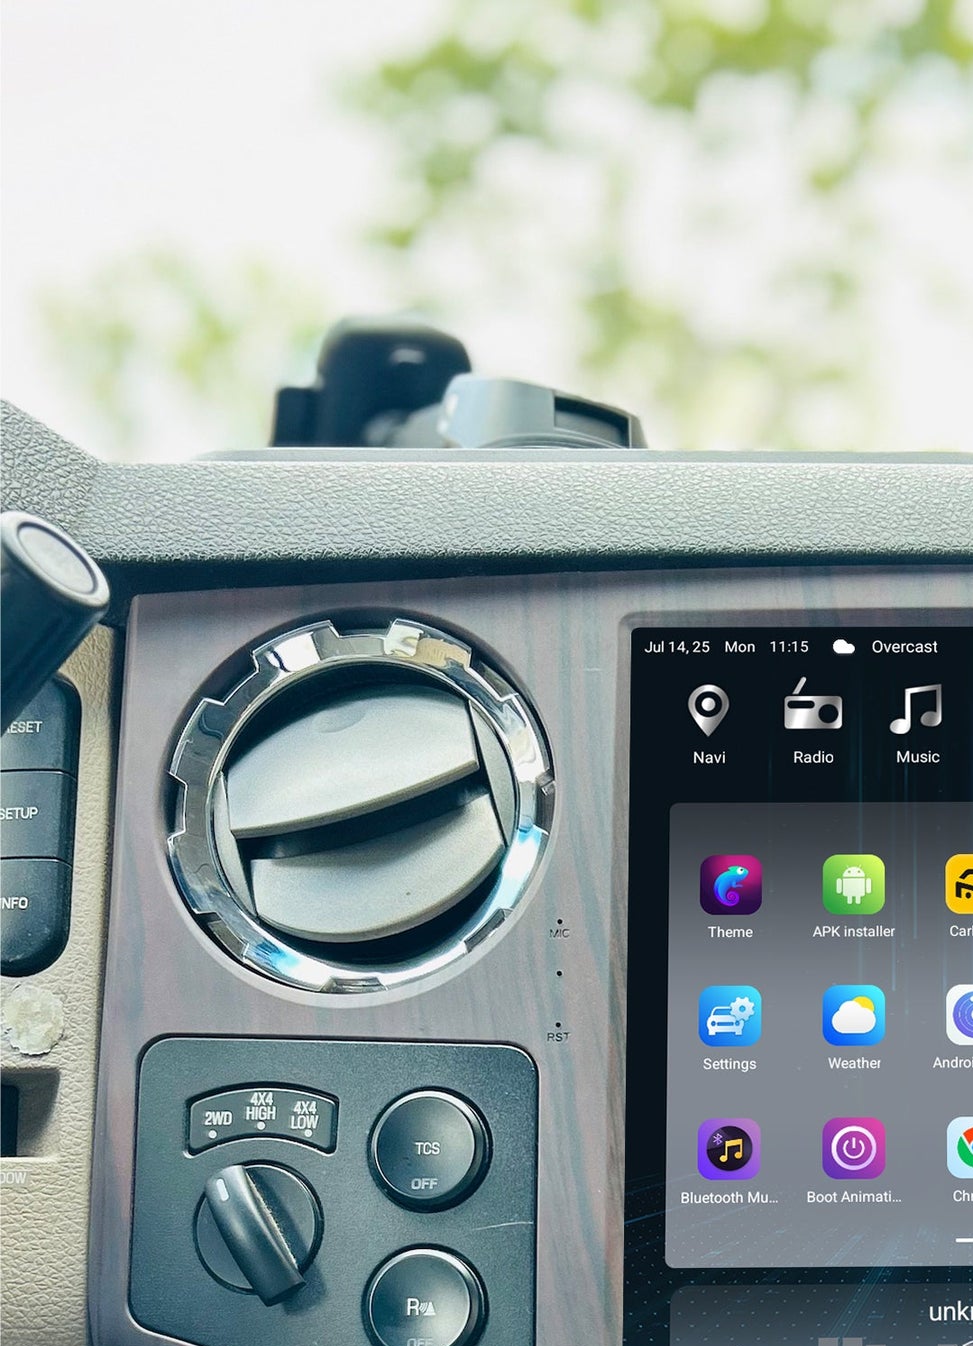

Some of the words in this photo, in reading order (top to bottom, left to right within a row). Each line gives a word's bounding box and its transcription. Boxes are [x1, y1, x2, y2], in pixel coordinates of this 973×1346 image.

[644, 640, 664, 653] Jul
[692, 641, 710, 653] 25
[724, 641, 755, 652] Mon
[770, 641, 809, 652] 11:15
[872, 640, 937, 653] Overcast
[7, 720, 42, 734] ESET
[693, 752, 725, 763] Navi
[793, 751, 833, 763] Radio
[896, 751, 939, 763] Music
[0, 806, 38, 820] SETUP
[0, 896, 29, 909] NFO
[549, 928, 570, 938] MIC
[707, 926, 753, 937] Theme
[812, 926, 840, 937] APK
[844, 926, 895, 937] installer
[547, 1032, 570, 1042] RST
[703, 1058, 756, 1072] Settings
[827, 1057, 880, 1068] Weather
[250, 1092, 274, 1106] 4X4
[246, 1106, 276, 1120] HIGH
[293, 1101, 317, 1115] 4X4
[204, 1111, 233, 1125] 2WD
[291, 1115, 319, 1129] LOW
[415, 1141, 441, 1155] TCS
[411, 1178, 438, 1190] OFF
[680, 1192, 743, 1203] Bluetooth
[807, 1191, 838, 1203] Boot
